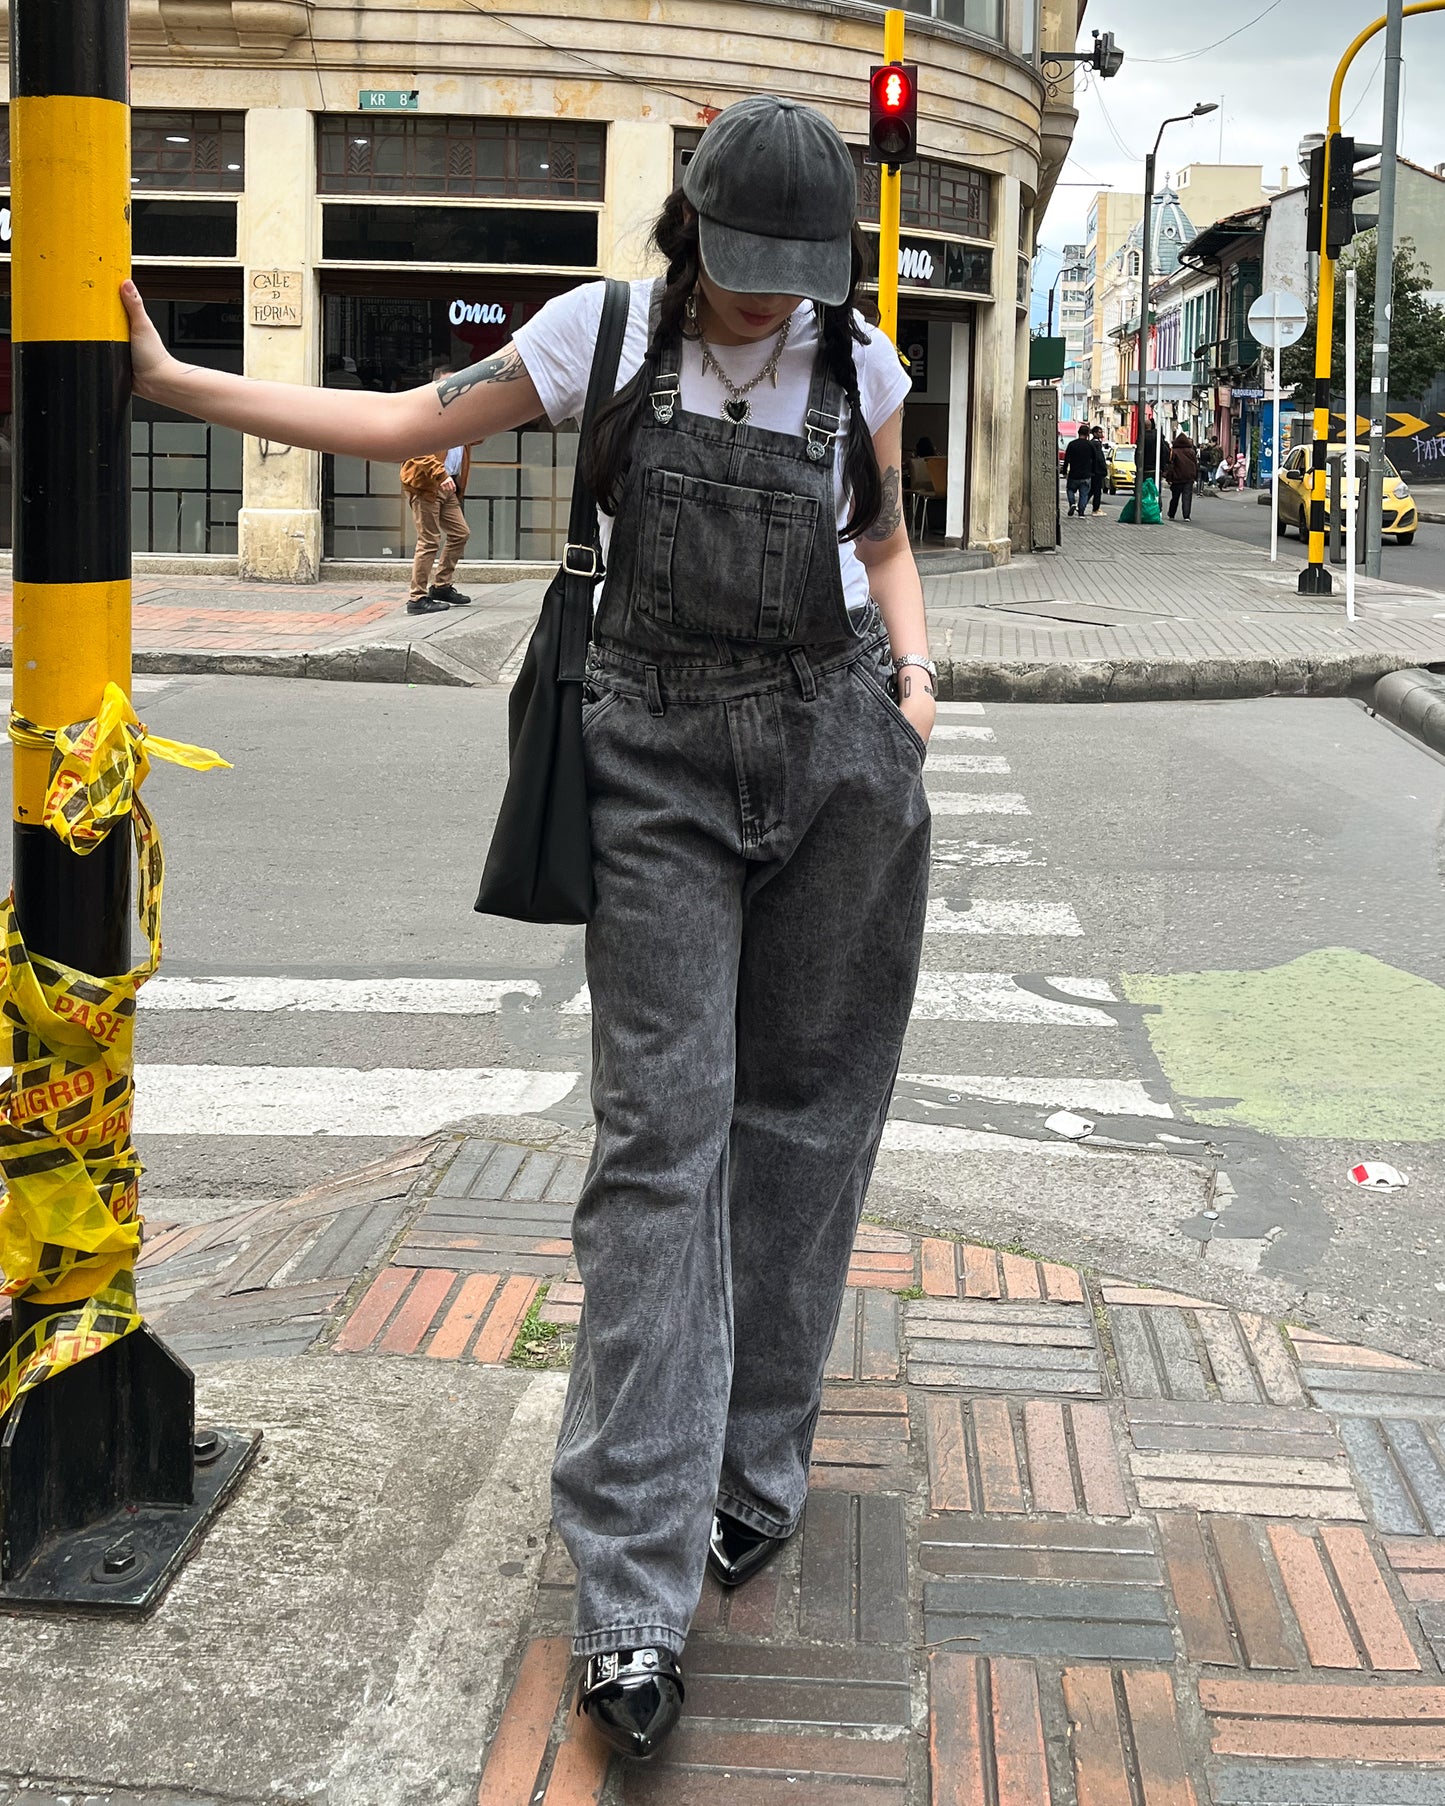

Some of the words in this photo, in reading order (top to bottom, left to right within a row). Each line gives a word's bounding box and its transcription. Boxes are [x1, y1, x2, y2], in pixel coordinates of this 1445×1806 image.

[370, 93, 386, 106] KR
[399, 93, 408, 106] 8
[898, 246, 934, 280] ma
[253, 272, 290, 290] CALLE
[253, 304, 297, 321] FLORIAN
[448, 299, 507, 325] Oma
[53, 995, 126, 1043] PASE
